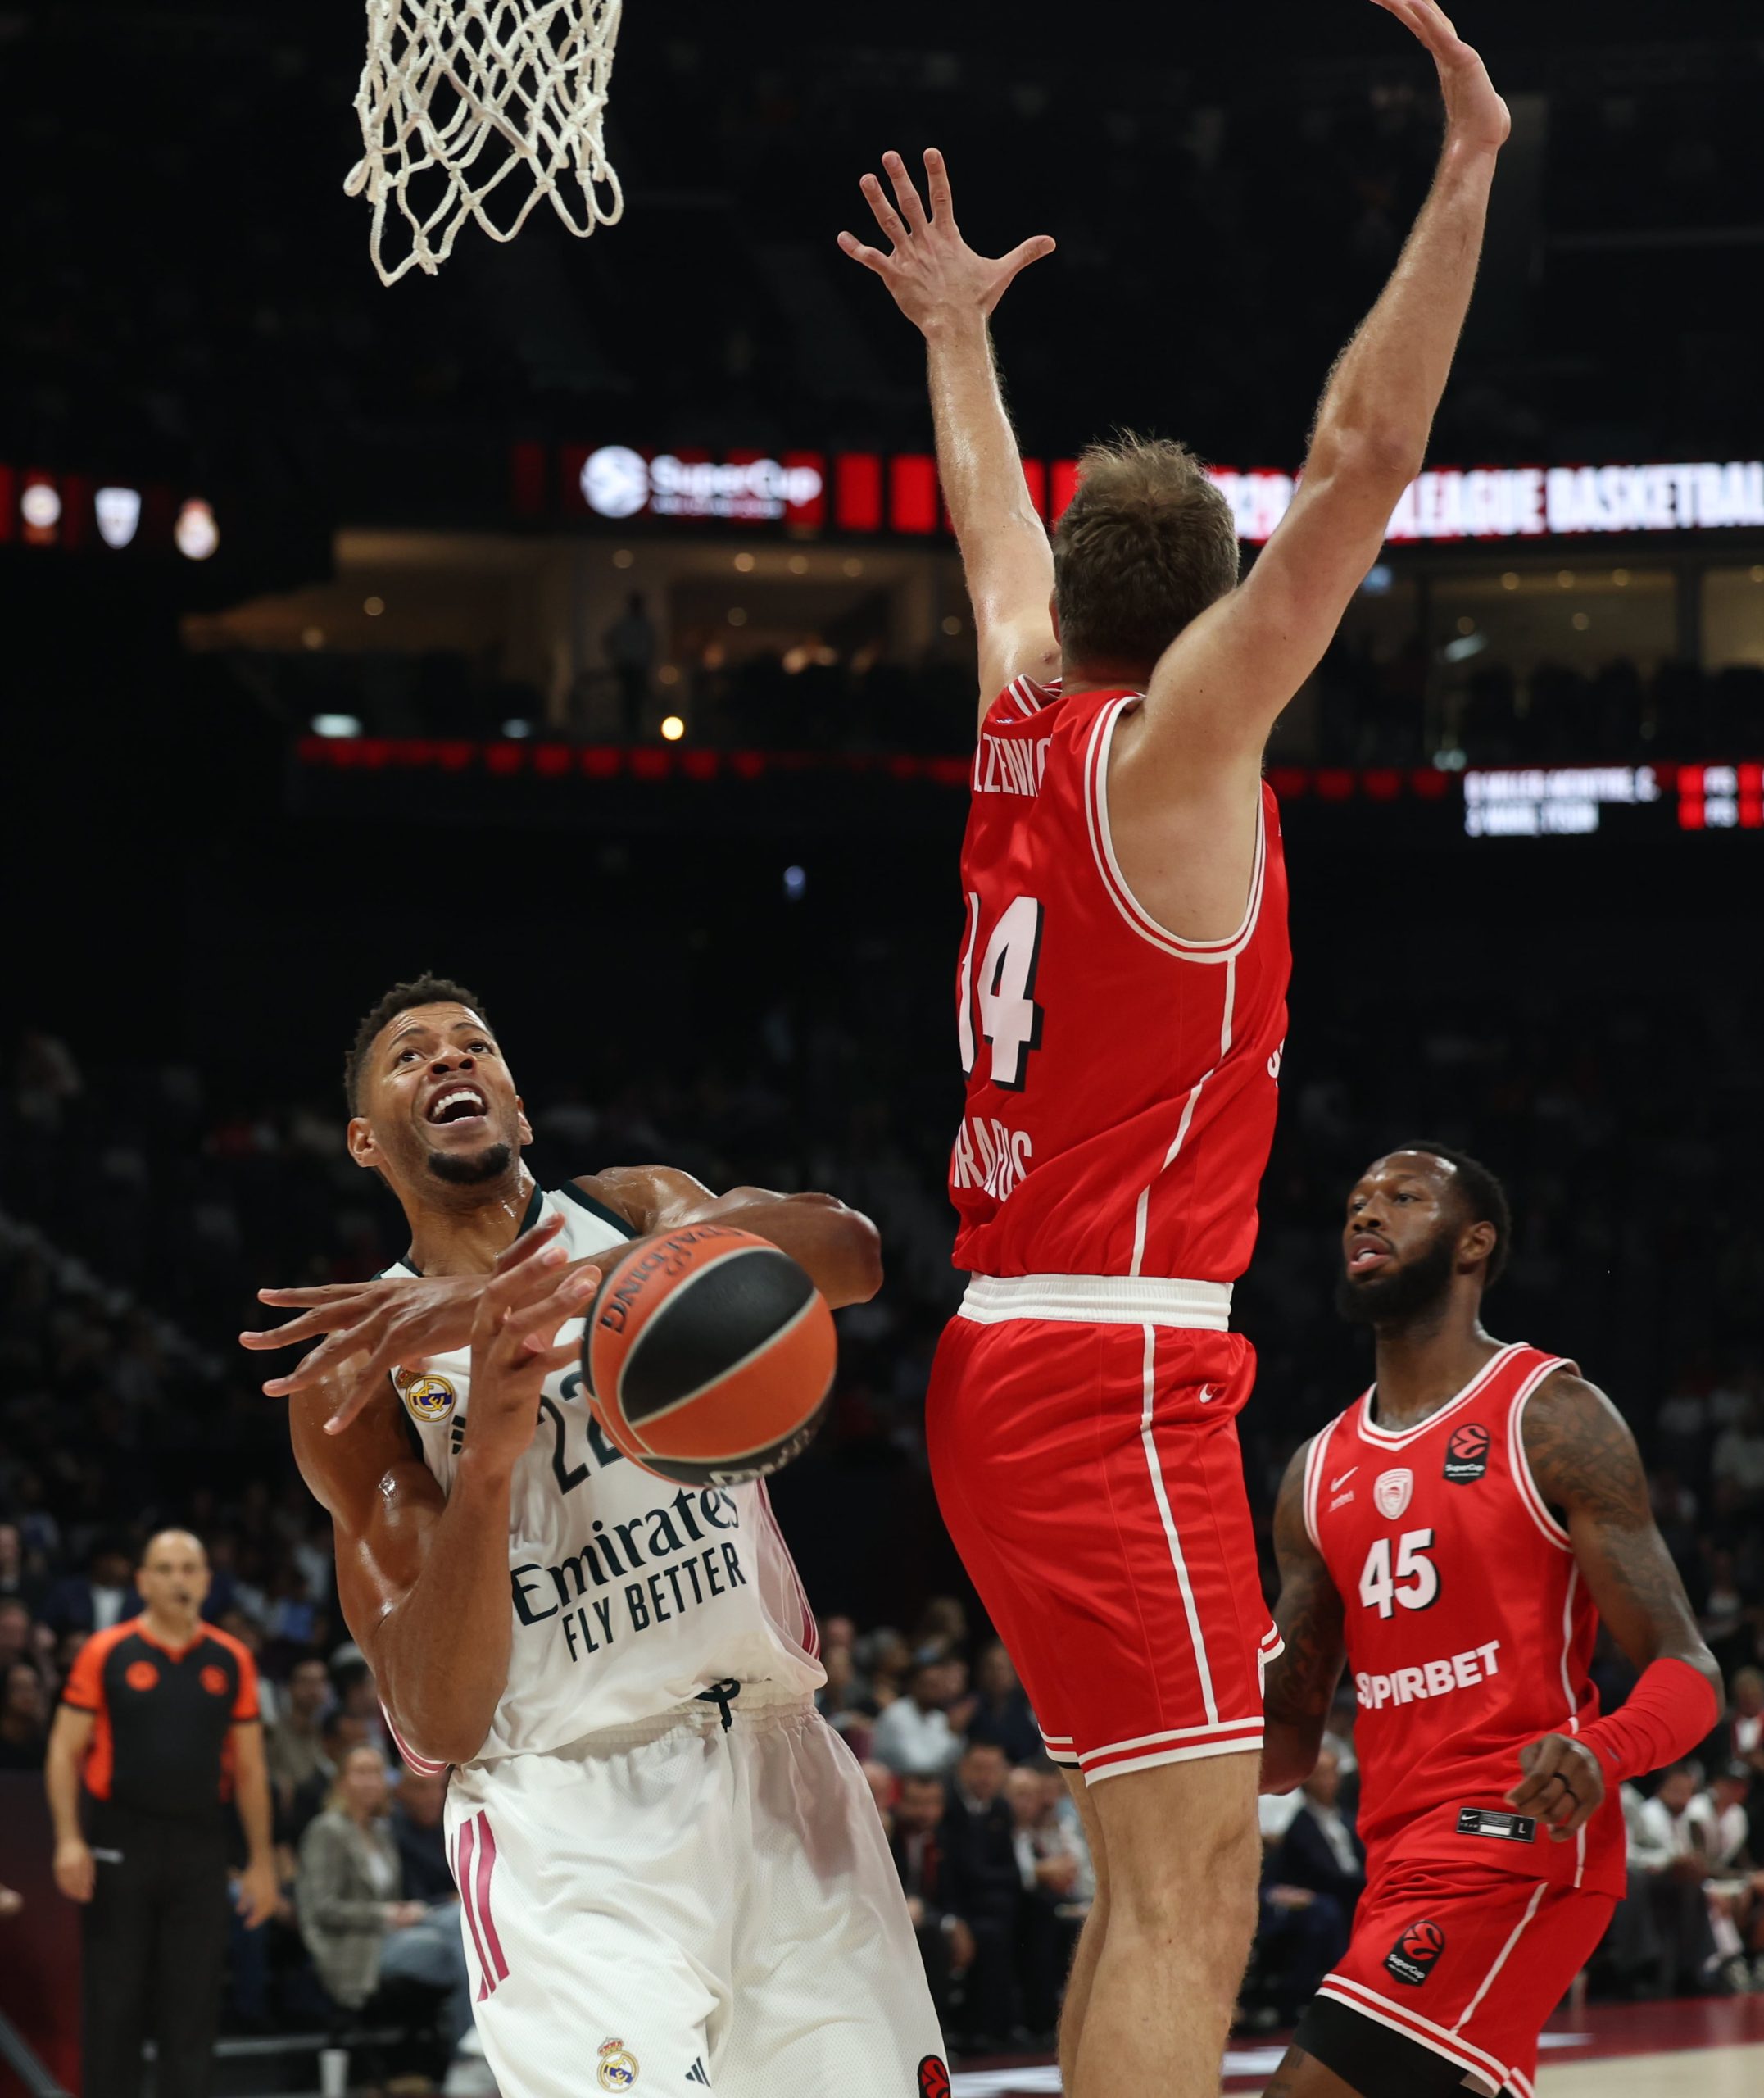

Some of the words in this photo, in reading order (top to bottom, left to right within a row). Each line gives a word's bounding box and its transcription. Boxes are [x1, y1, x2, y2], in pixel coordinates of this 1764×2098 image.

[959, 892, 1044, 1092] 14
[510, 1486, 739, 1627] Emirates
[562, 1596, 614, 1663] FLY
[624, 1542, 747, 1633] BETTER
[1358, 1528, 1442, 1619] 45
[1518, 1823, 1526, 1834] L
